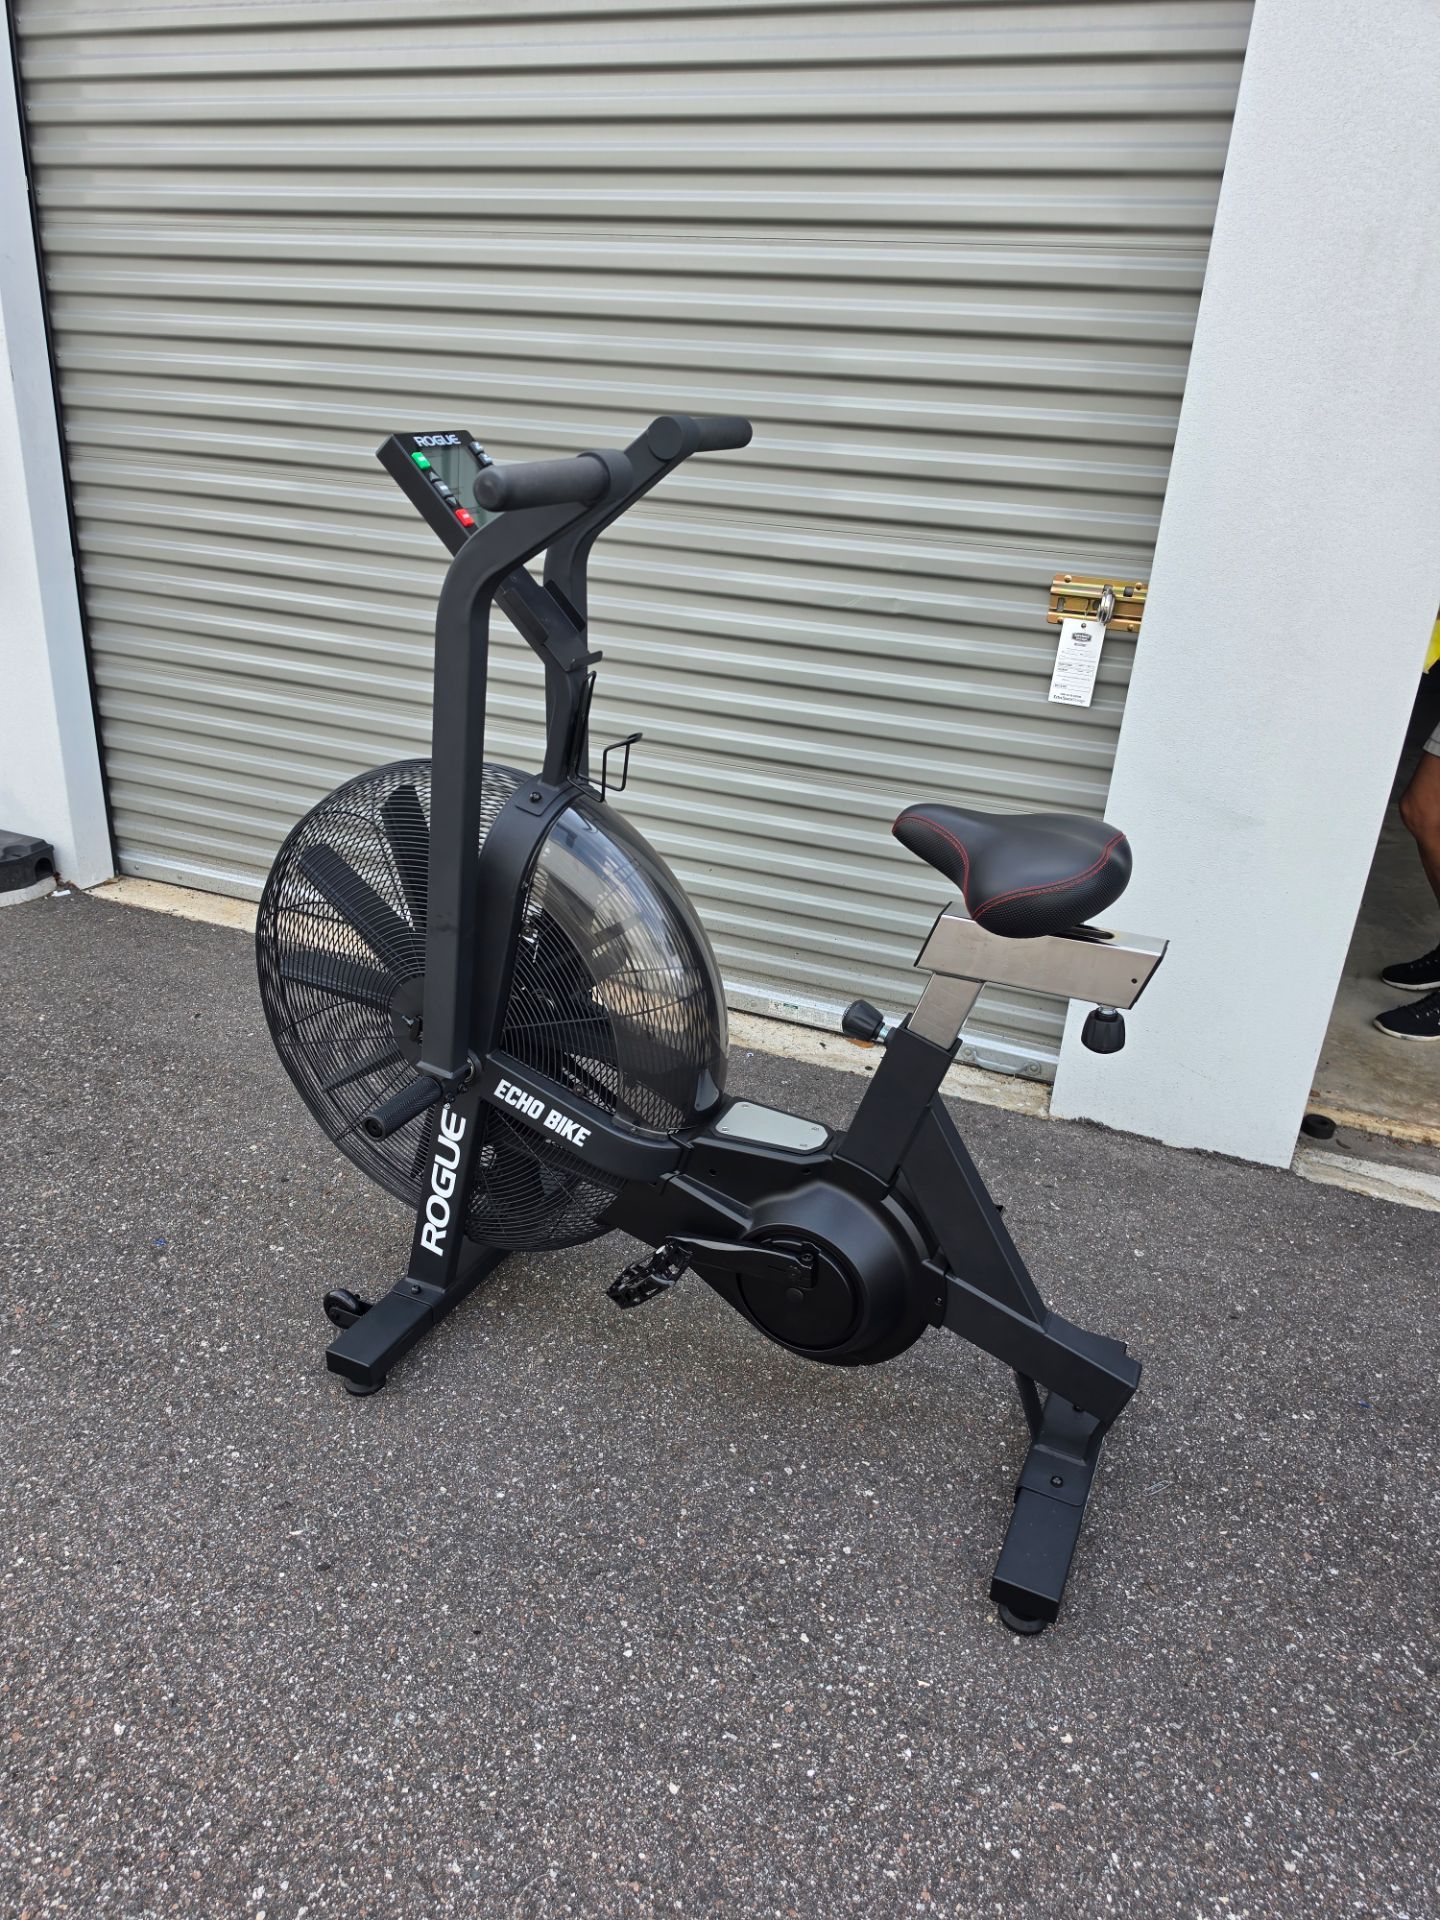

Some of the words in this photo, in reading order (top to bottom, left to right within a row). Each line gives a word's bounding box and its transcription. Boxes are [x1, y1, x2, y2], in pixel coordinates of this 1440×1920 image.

[413, 434, 461, 447] ROGUE
[493, 1079, 545, 1120] ECHO
[543, 1109, 592, 1147] BIKE
[420, 1108, 467, 1257] ROGUE
